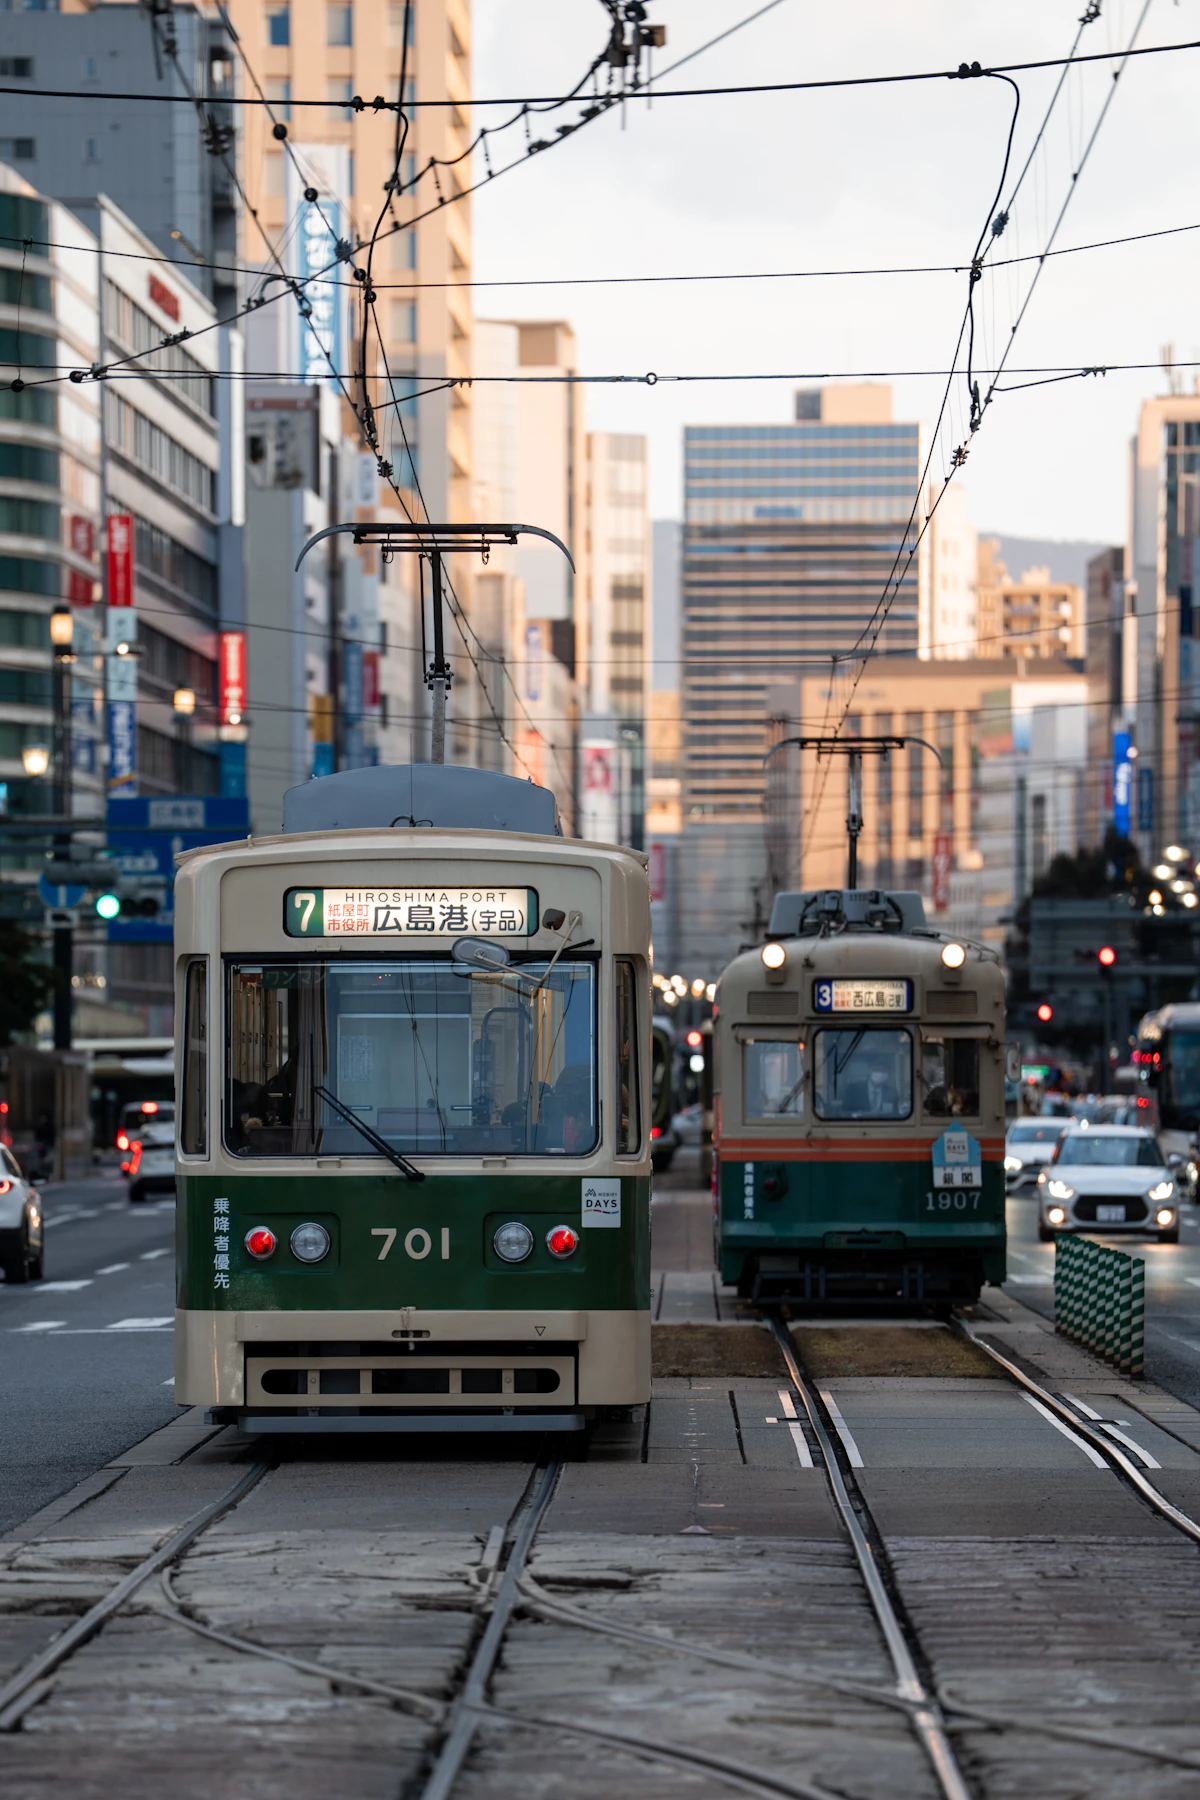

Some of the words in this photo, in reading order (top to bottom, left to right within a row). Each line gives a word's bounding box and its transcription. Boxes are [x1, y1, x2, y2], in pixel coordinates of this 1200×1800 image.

[345, 892, 449, 902] HIROSHIMA
[460, 892, 507, 902] PORT
[294, 893, 316, 932] 7
[328, 904, 370, 917] 紙屋町
[372, 904, 524, 932] 広島港(宇品)
[328, 918, 370, 932] 市役所
[818, 984, 831, 1006] 3
[585, 1199, 618, 1208] DAYS
[925, 1191, 981, 1211] 1907
[213, 1197, 230, 1289] 乗降者優先
[370, 1227, 450, 1261] 701
